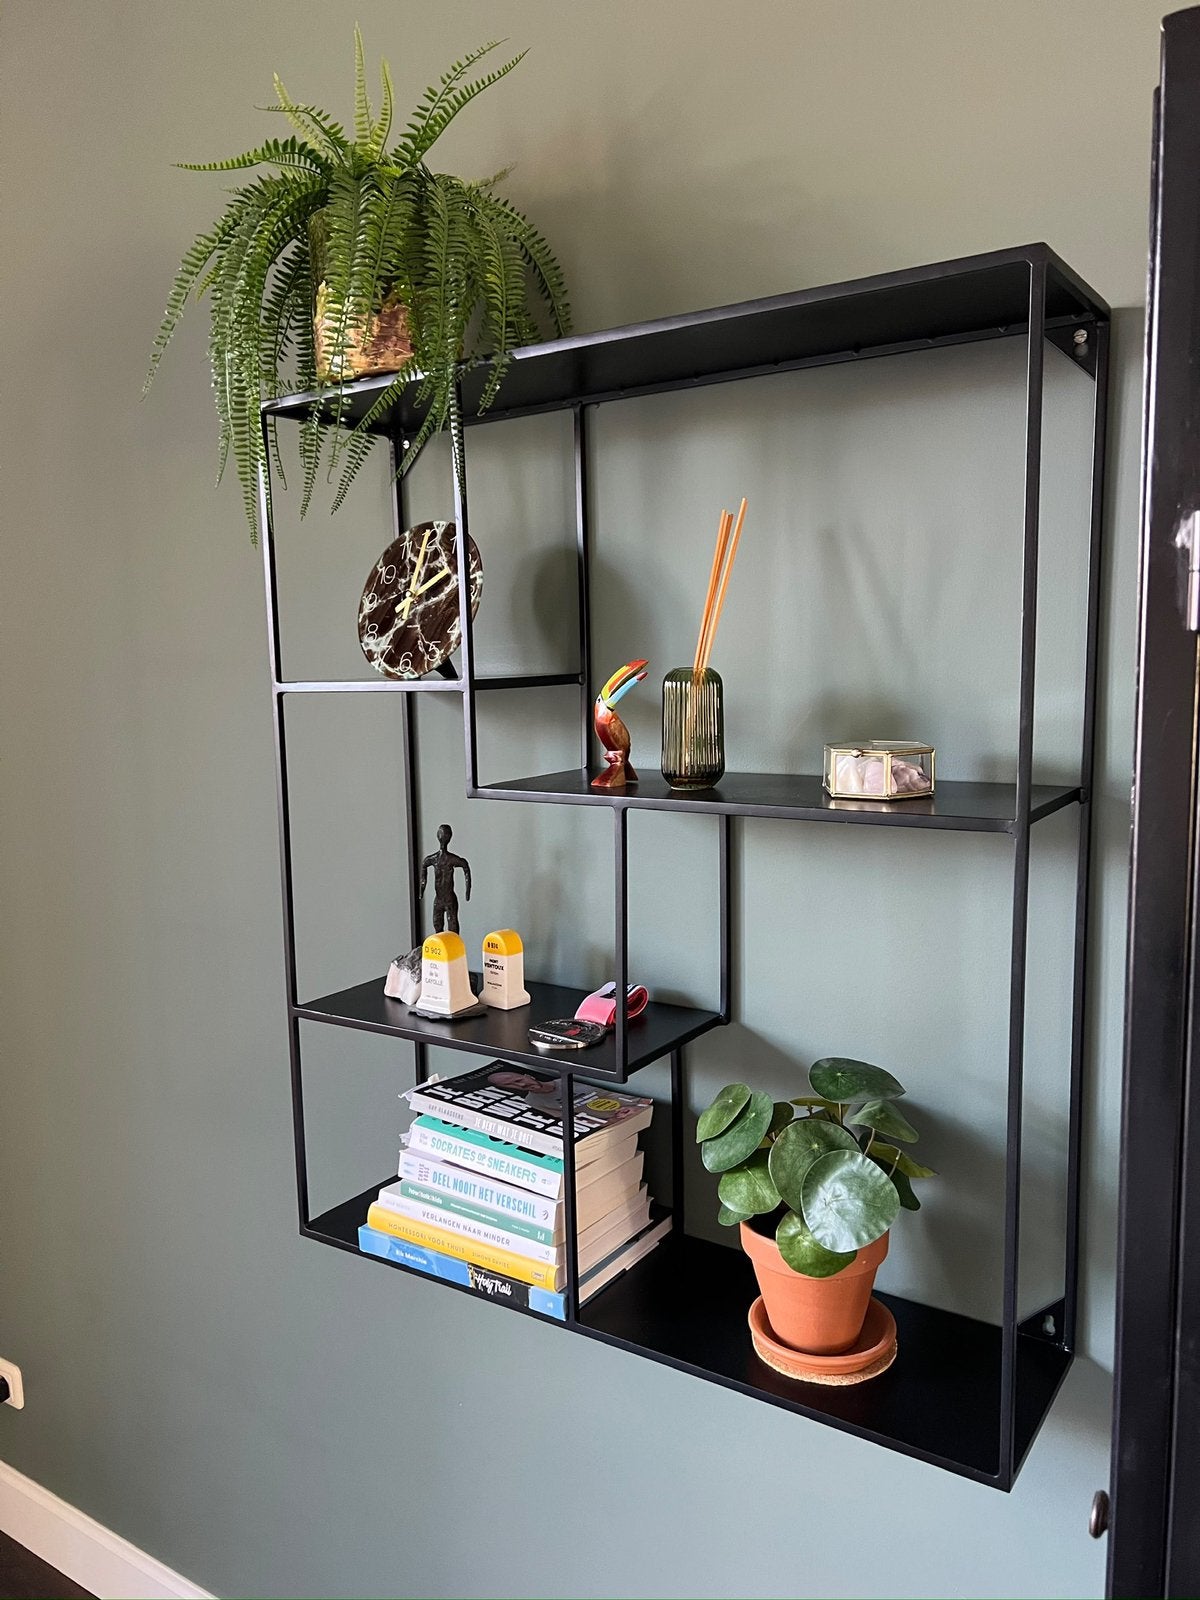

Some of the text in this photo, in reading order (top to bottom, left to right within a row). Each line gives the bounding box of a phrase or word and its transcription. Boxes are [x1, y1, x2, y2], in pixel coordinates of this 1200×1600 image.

[380, 564, 396, 584] 10
[366, 624, 378, 642] 8
[400, 652, 412, 672] 6
[424, 1084, 464, 1100] JE
[453, 1086, 514, 1108] BENT
[512, 1112, 556, 1128] JE
[430, 1137, 476, 1162] SOCRATES
[488, 1156, 537, 1184] SNEAKERS
[432, 1171, 451, 1188] DEEL
[452, 1178, 477, 1197] NOOIT
[478, 1187, 494, 1203] HET
[495, 1192, 537, 1219] VERSCHIL
[422, 1210, 460, 1228] VERLANGEN
[462, 1224, 484, 1236] NAAR
[483, 1232, 511, 1246] MINDER
